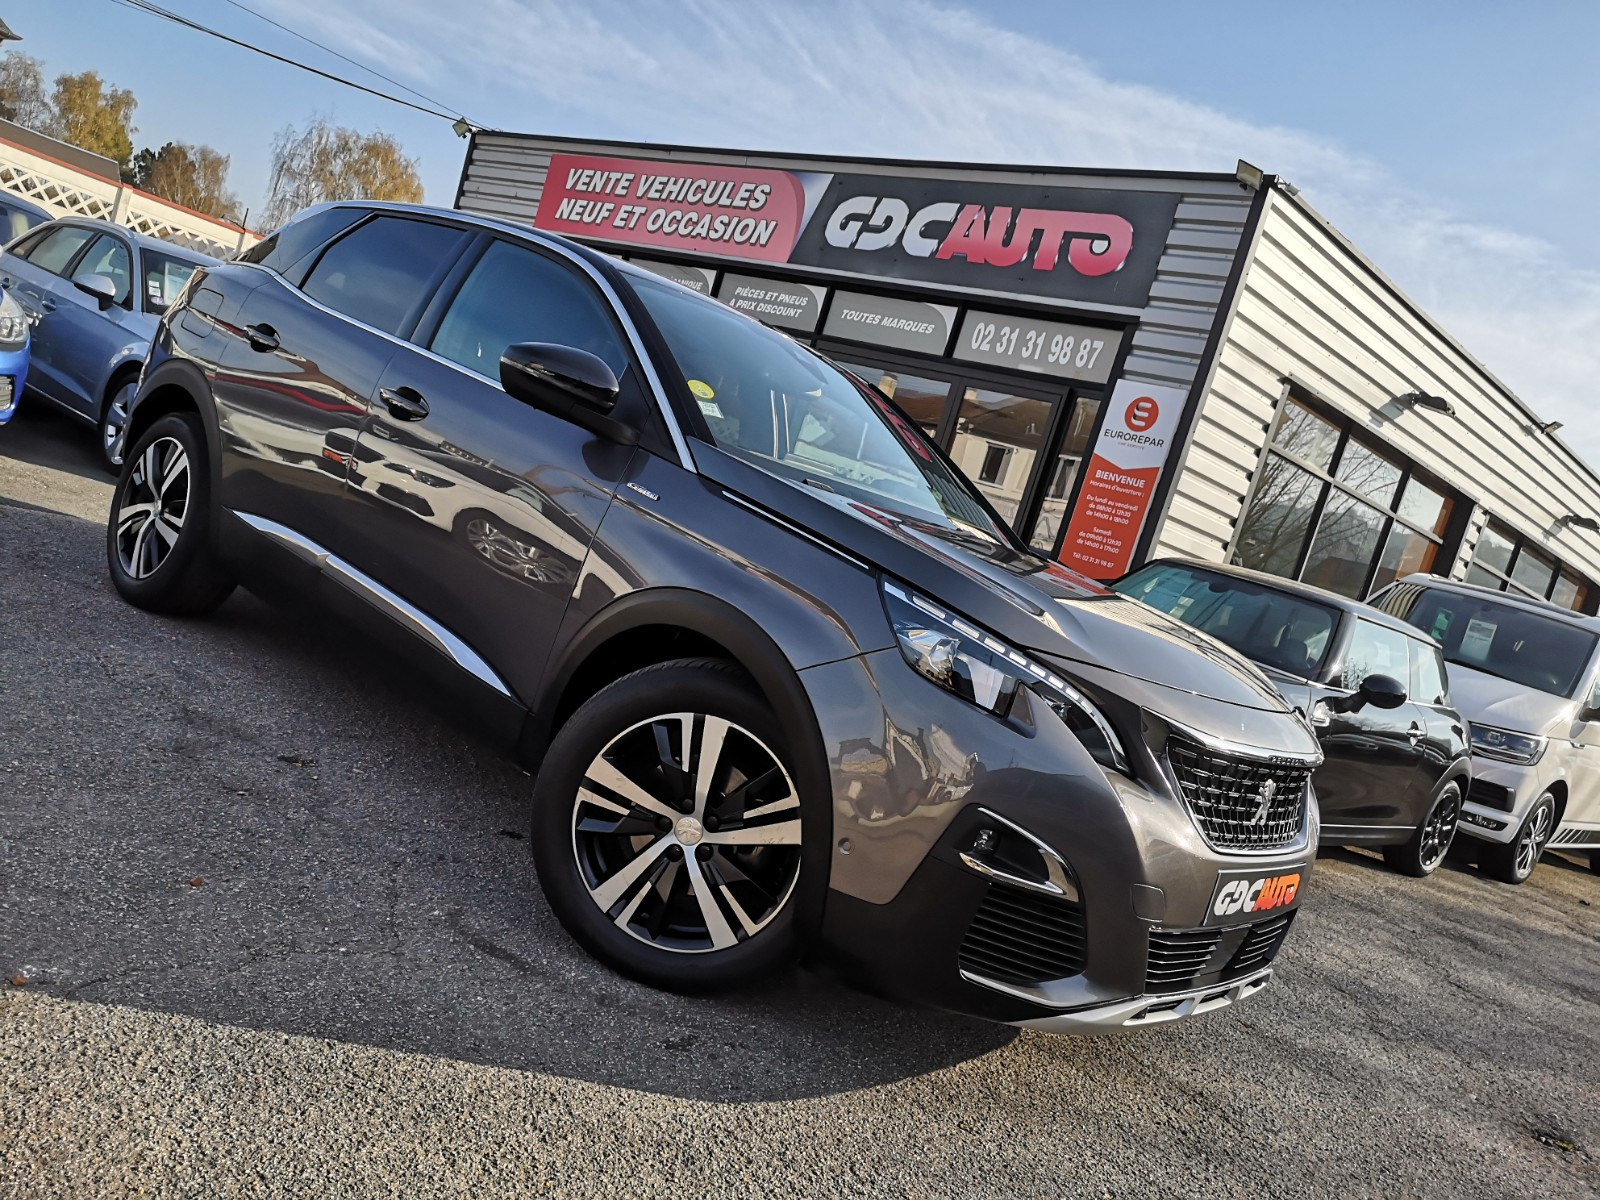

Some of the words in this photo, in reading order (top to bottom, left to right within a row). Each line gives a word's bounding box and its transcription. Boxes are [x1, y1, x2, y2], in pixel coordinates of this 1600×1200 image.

[565, 168, 635, 197] VENTE
[635, 174, 771, 209] VEHICULES
[554, 198, 615, 224] NEUF
[613, 205, 646, 229] ET
[646, 208, 777, 246] OCCASION
[734, 286, 764, 300] PIÈCES
[764, 292, 779, 301] ET
[777, 294, 808, 306] PNEUS
[735, 300, 757, 311] PRIX
[757, 303, 803, 318] DISCOUNT
[841, 309, 881, 324] TOUTES
[881, 317, 935, 334] MARQUES
[971, 322, 995, 352] 02
[996, 326, 1020, 355] 31
[1021, 330, 1046, 360] 31
[1048, 334, 1075, 365] 98
[1075, 338, 1105, 369] 87
[1104, 429, 1165, 447] EUROREPAR
[1089, 480, 1111, 489] Horaires
[1095, 469, 1146, 488] BIENVENUE
[1094, 495, 1108, 504] lundi
[1115, 502, 1138, 511] vendredi
[1093, 526, 1112, 536] Samedi
